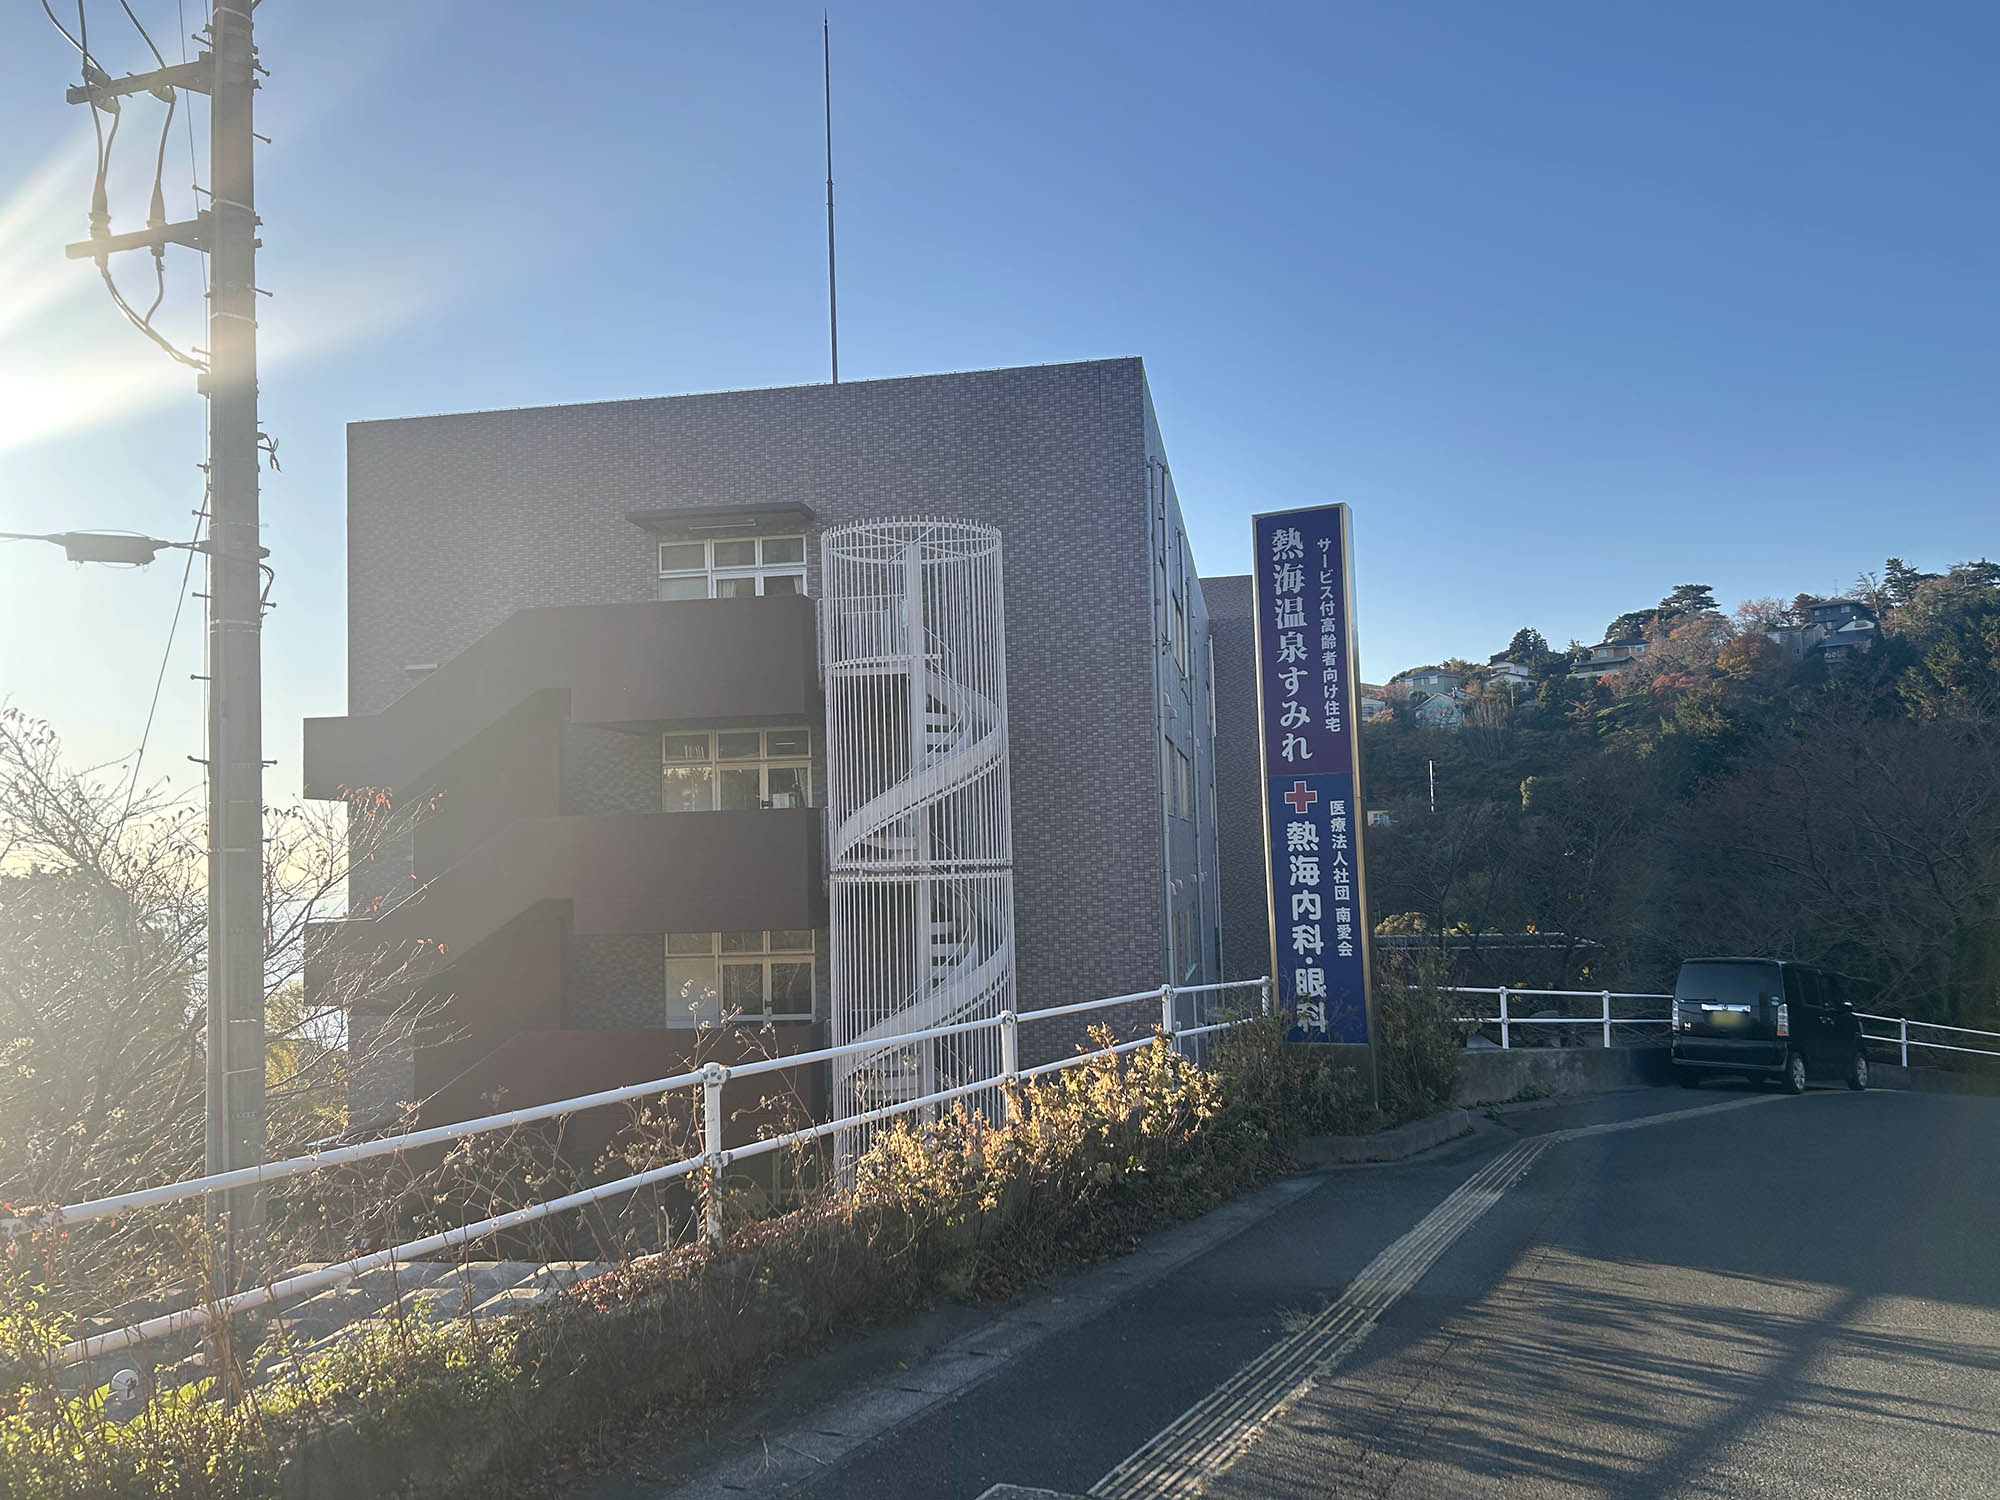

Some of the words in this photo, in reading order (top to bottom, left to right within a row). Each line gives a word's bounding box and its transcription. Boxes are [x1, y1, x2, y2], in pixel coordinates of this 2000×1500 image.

[1272, 528, 1313, 762] 熱海温泉すみれ
[1317, 538, 1341, 733] サービス付高齢者向け住宅
[1287, 821, 1327, 1033] 熱海内科・眼科
[1330, 800, 1350, 901] 医療法人社団
[1335, 906, 1352, 957] 南愛会
